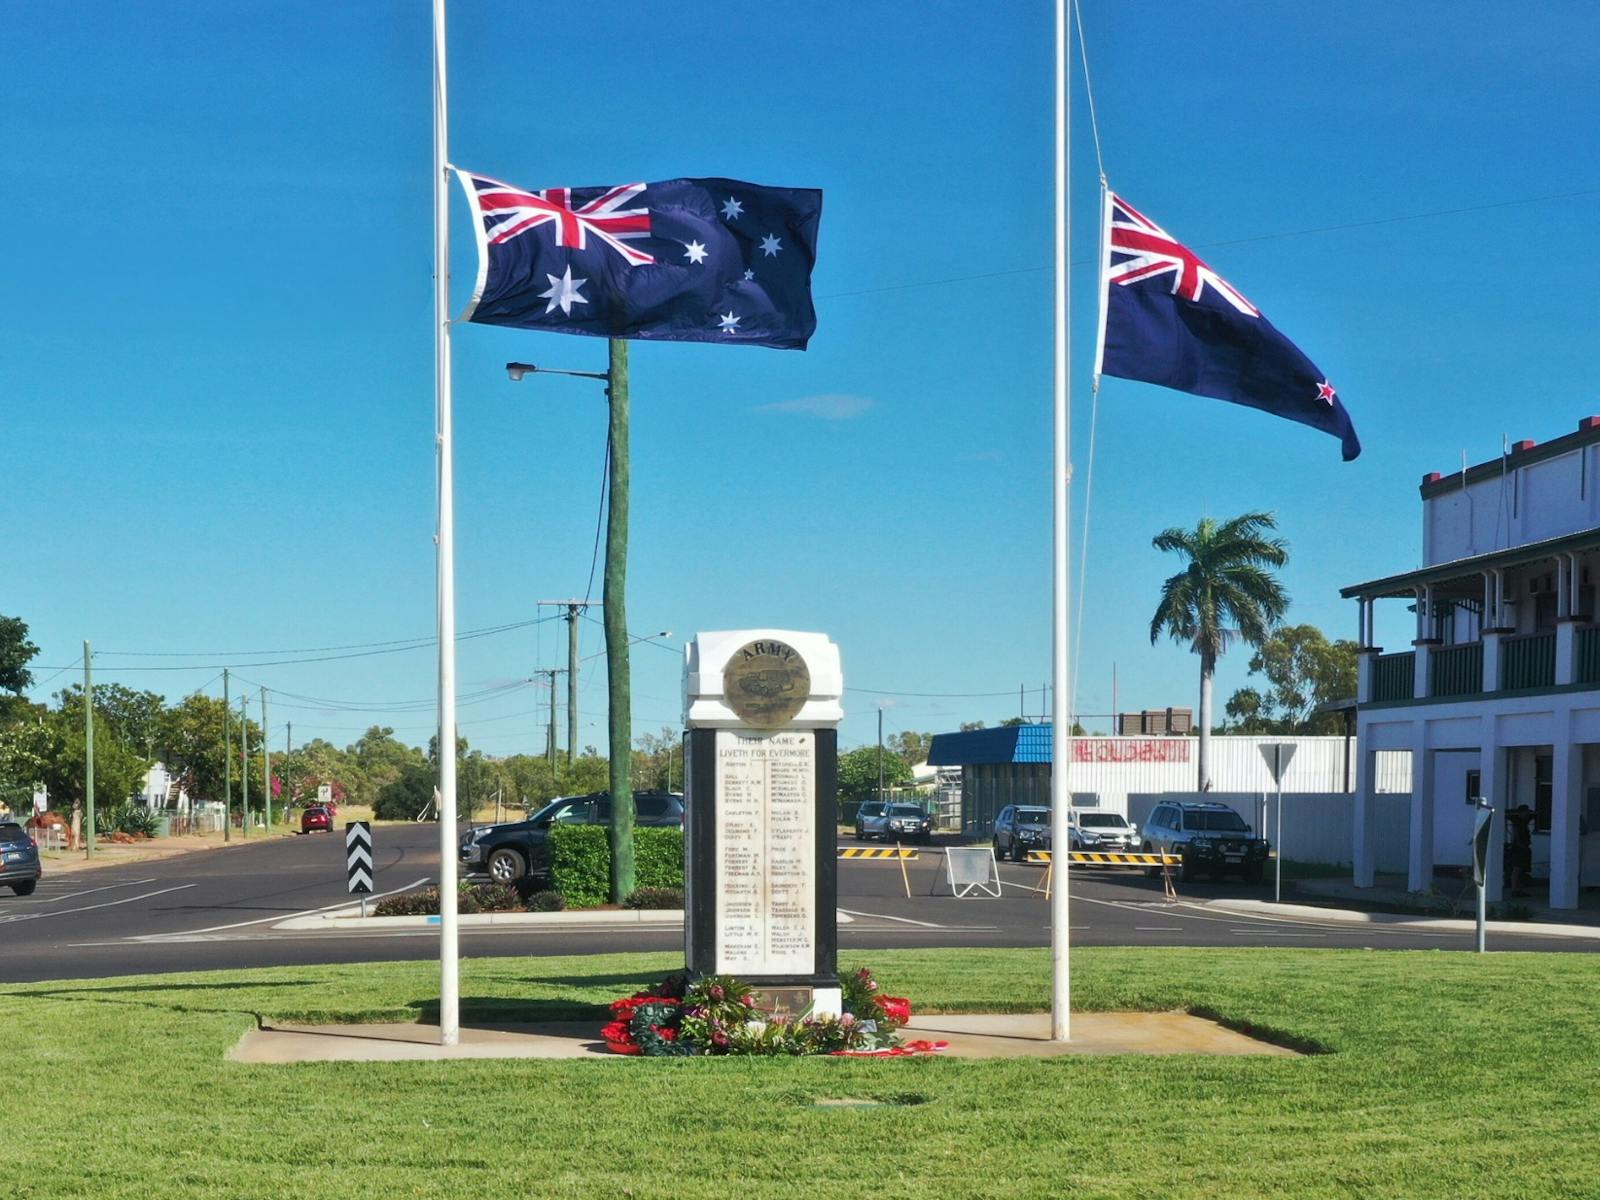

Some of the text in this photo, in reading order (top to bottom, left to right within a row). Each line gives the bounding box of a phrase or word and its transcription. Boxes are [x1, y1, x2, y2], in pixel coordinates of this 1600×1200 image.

[743, 642, 796, 661] ARMY
[769, 737, 795, 745] NAME
[719, 749, 809, 758] LIVETH FOR EVERMORE
